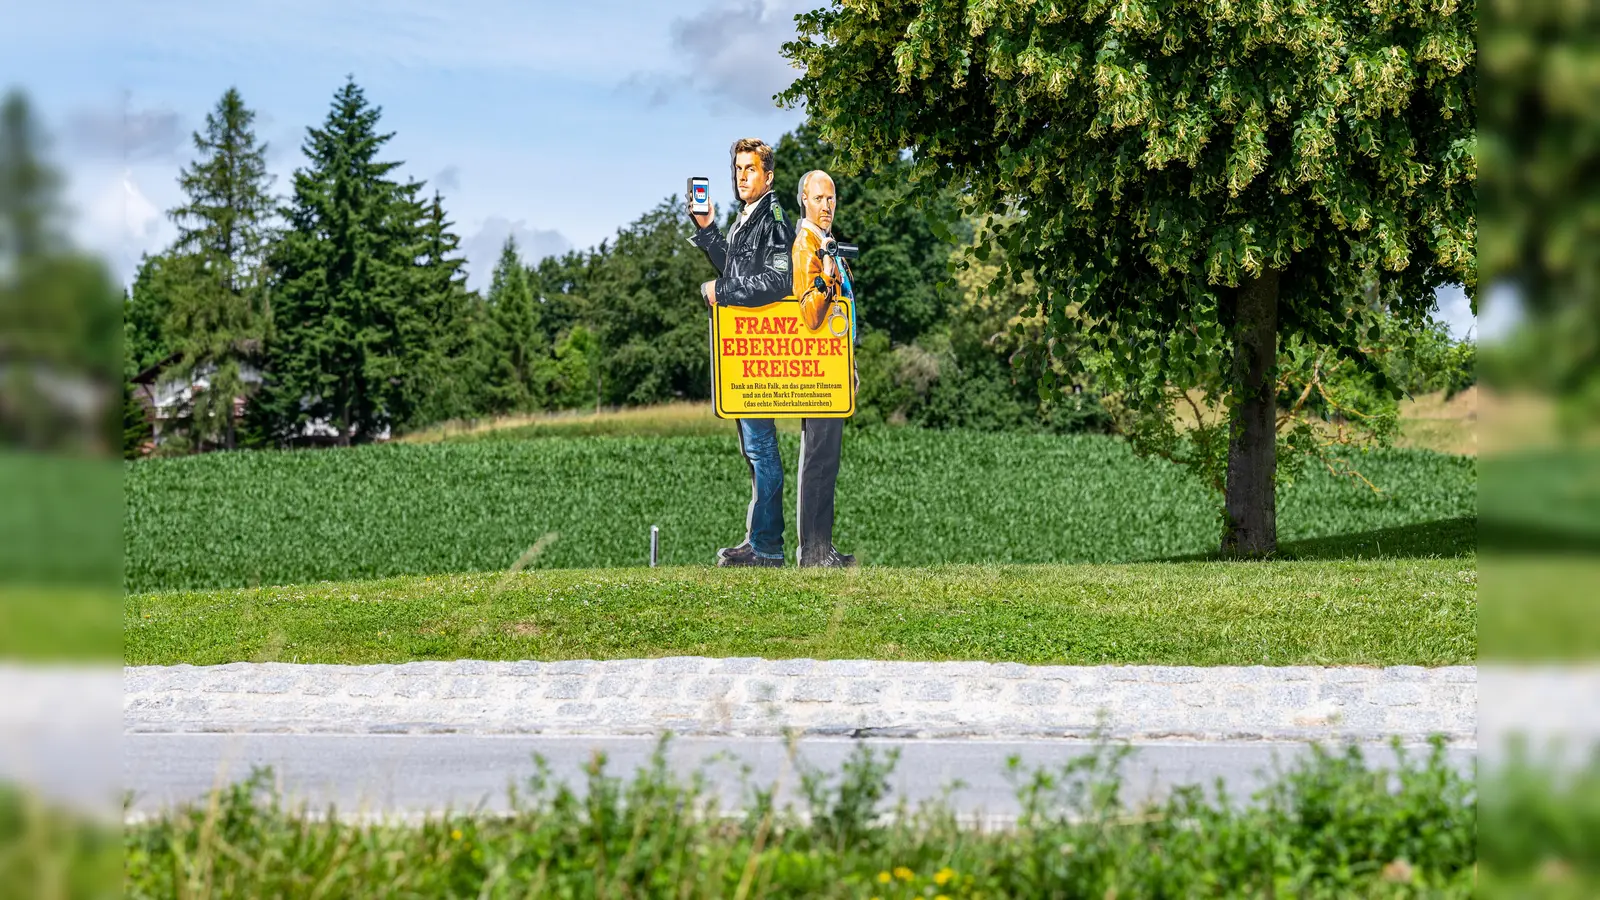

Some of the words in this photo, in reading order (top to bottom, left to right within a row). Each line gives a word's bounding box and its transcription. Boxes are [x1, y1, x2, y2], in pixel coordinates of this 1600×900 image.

[735, 317, 804, 334] FRANZ-
[723, 338, 846, 356] EBERHOFER-
[742, 360, 824, 377] KREISEL
